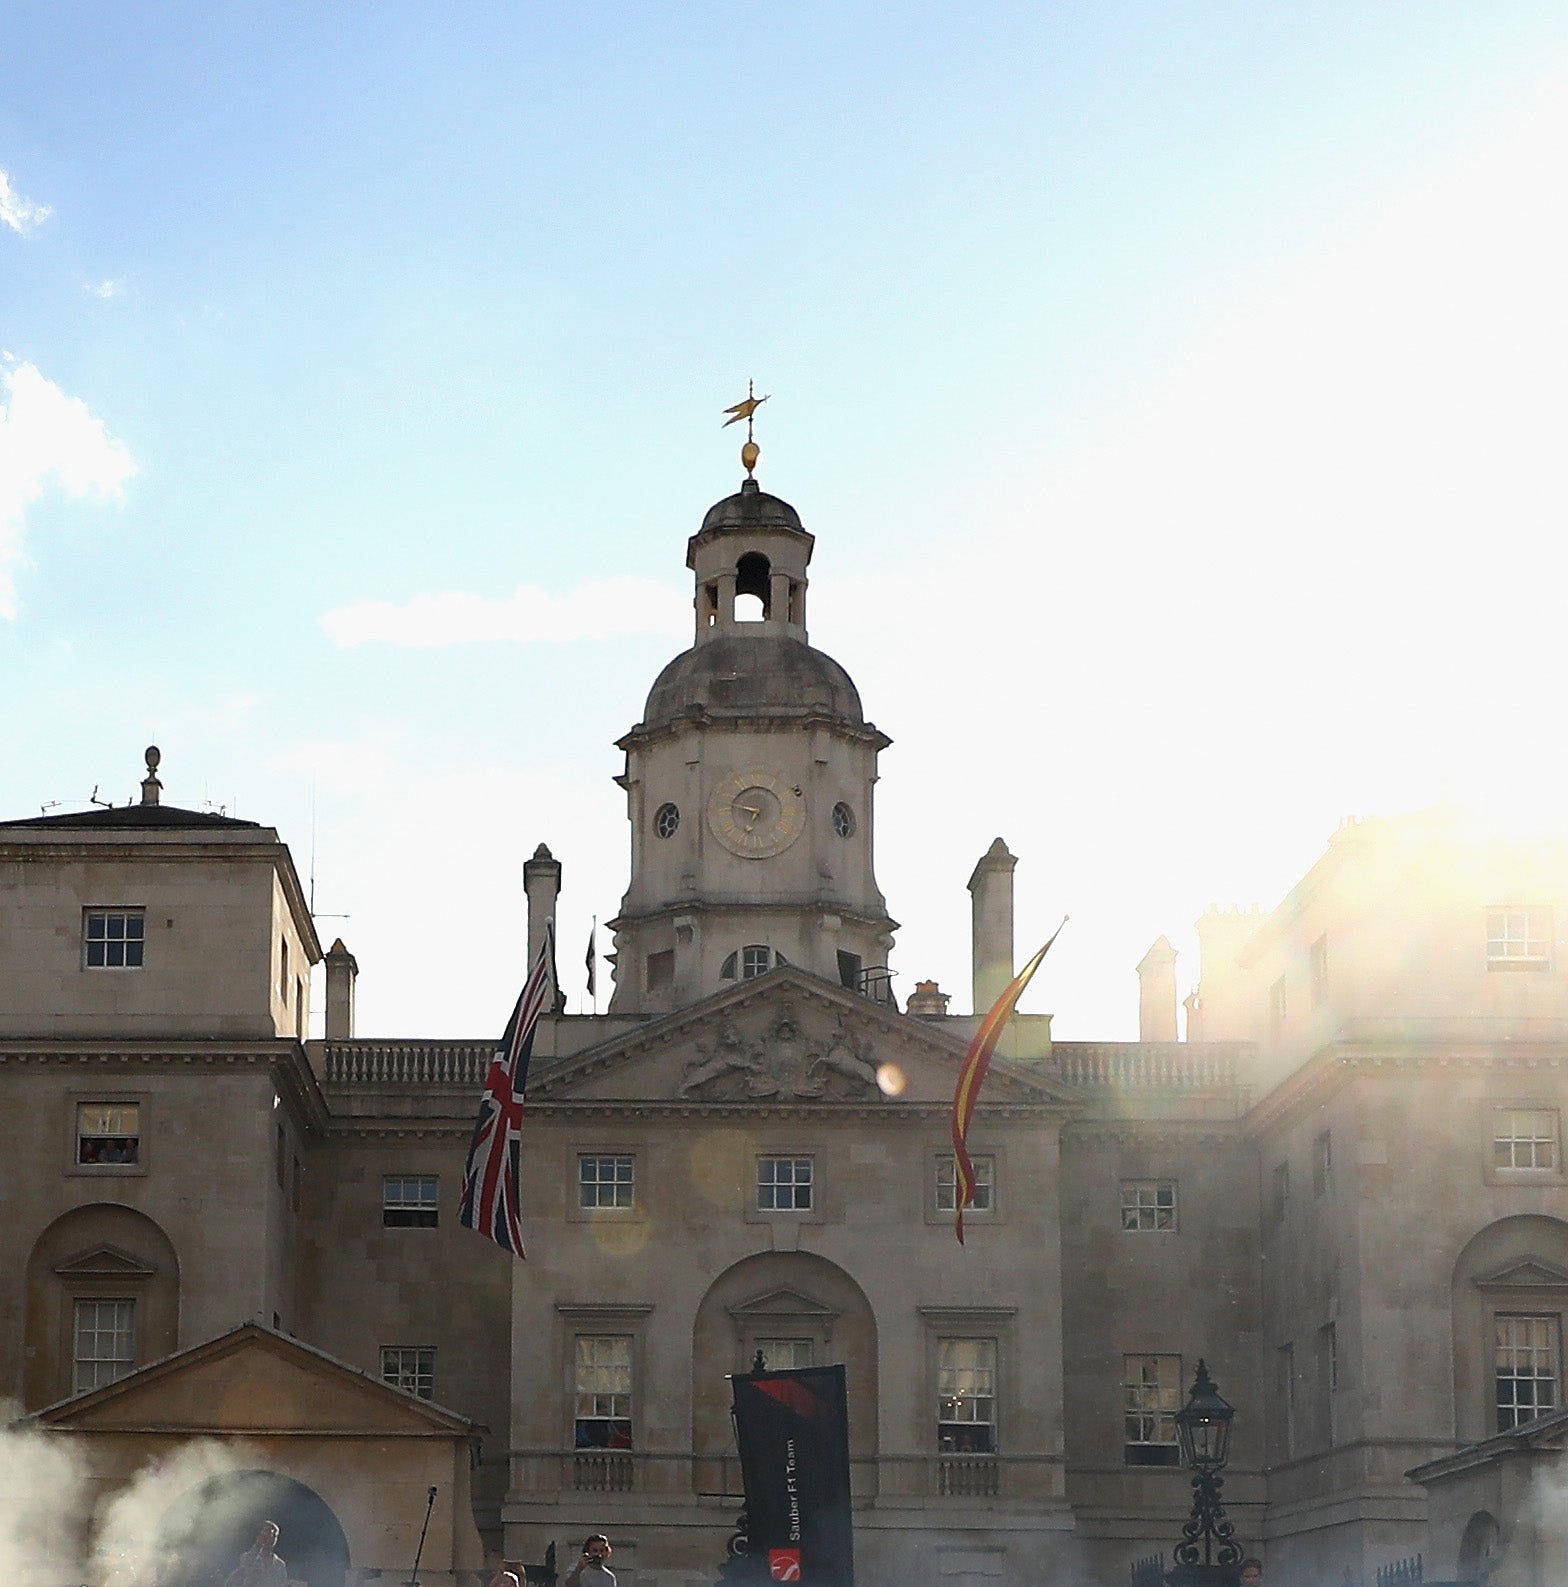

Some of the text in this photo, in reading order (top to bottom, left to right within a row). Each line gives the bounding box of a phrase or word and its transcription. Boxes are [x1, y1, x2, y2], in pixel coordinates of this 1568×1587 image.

[786, 1439, 801, 1541] Sauber F1 Team
